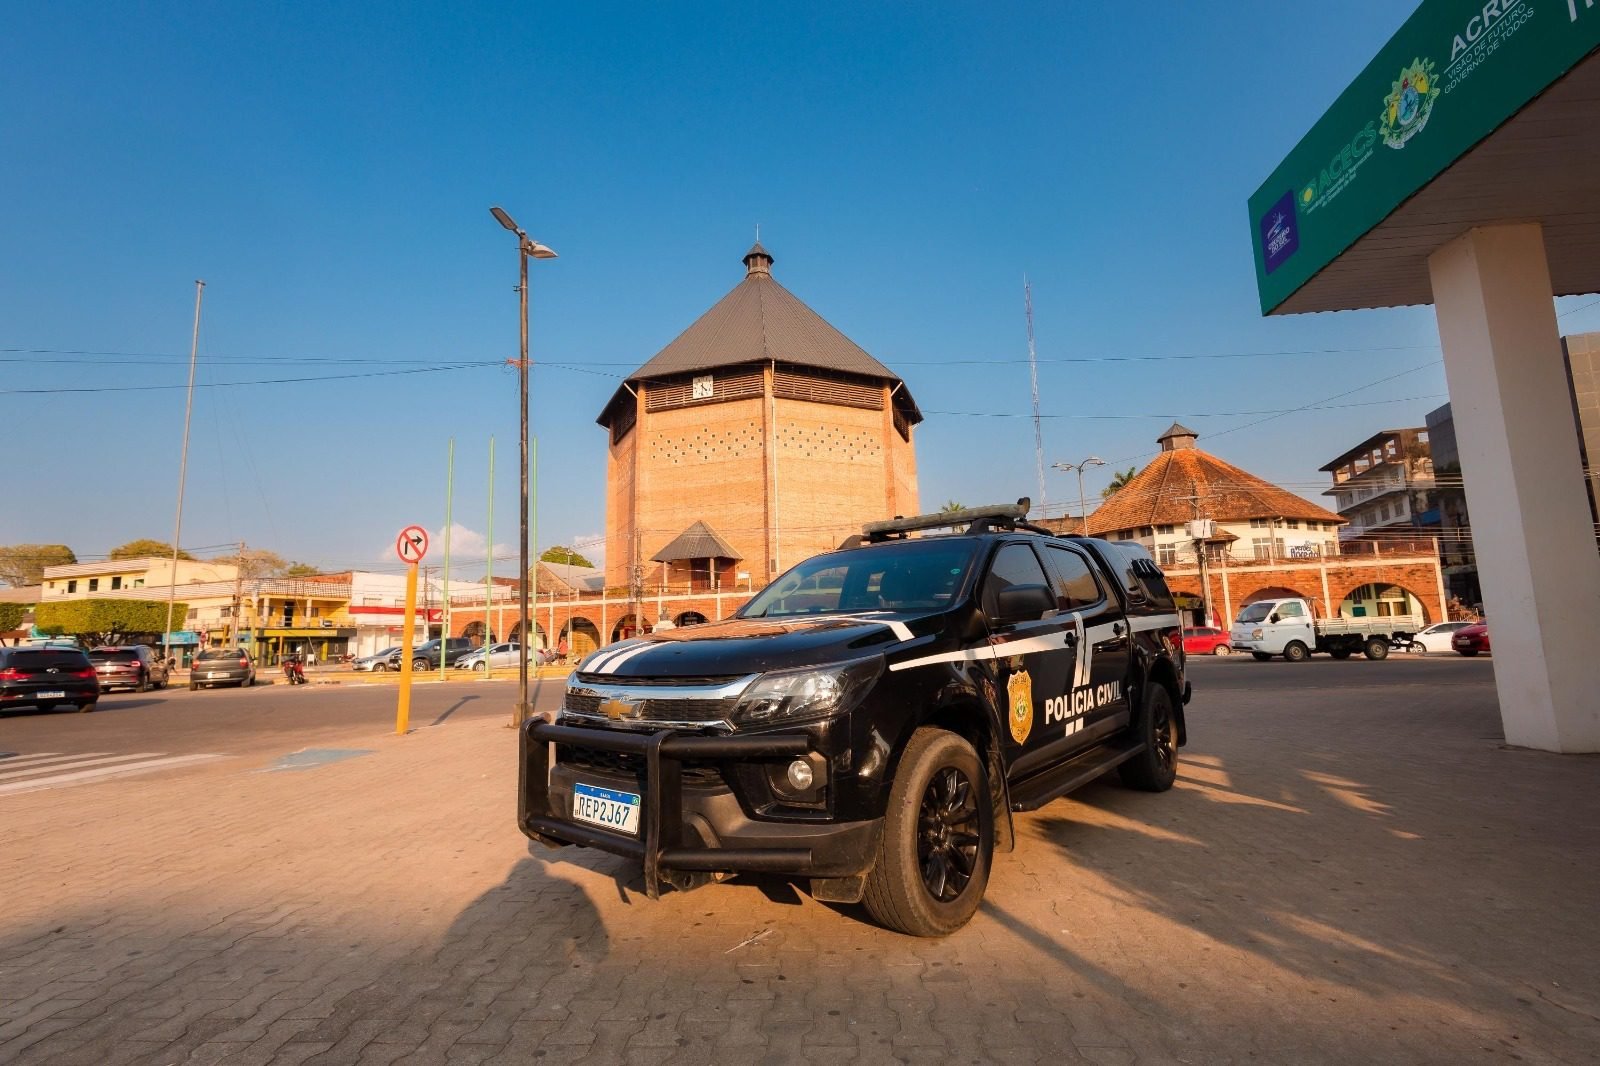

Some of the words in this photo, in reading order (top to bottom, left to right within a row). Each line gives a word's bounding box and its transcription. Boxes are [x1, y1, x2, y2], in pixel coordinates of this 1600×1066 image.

[1444, 53, 1485, 94] GOVERNO
[1487, 40, 1500, 55] DE
[1501, 7, 1534, 41] TODOS
[1474, 41, 1487, 56] DE
[1488, 3, 1526, 42] FUTURO
[1319, 121, 1377, 196] ACECS
[1045, 688, 1094, 725] POLÍCIA
[1097, 680, 1122, 707] CIVIL
[579, 797, 630, 826] REP2J67
